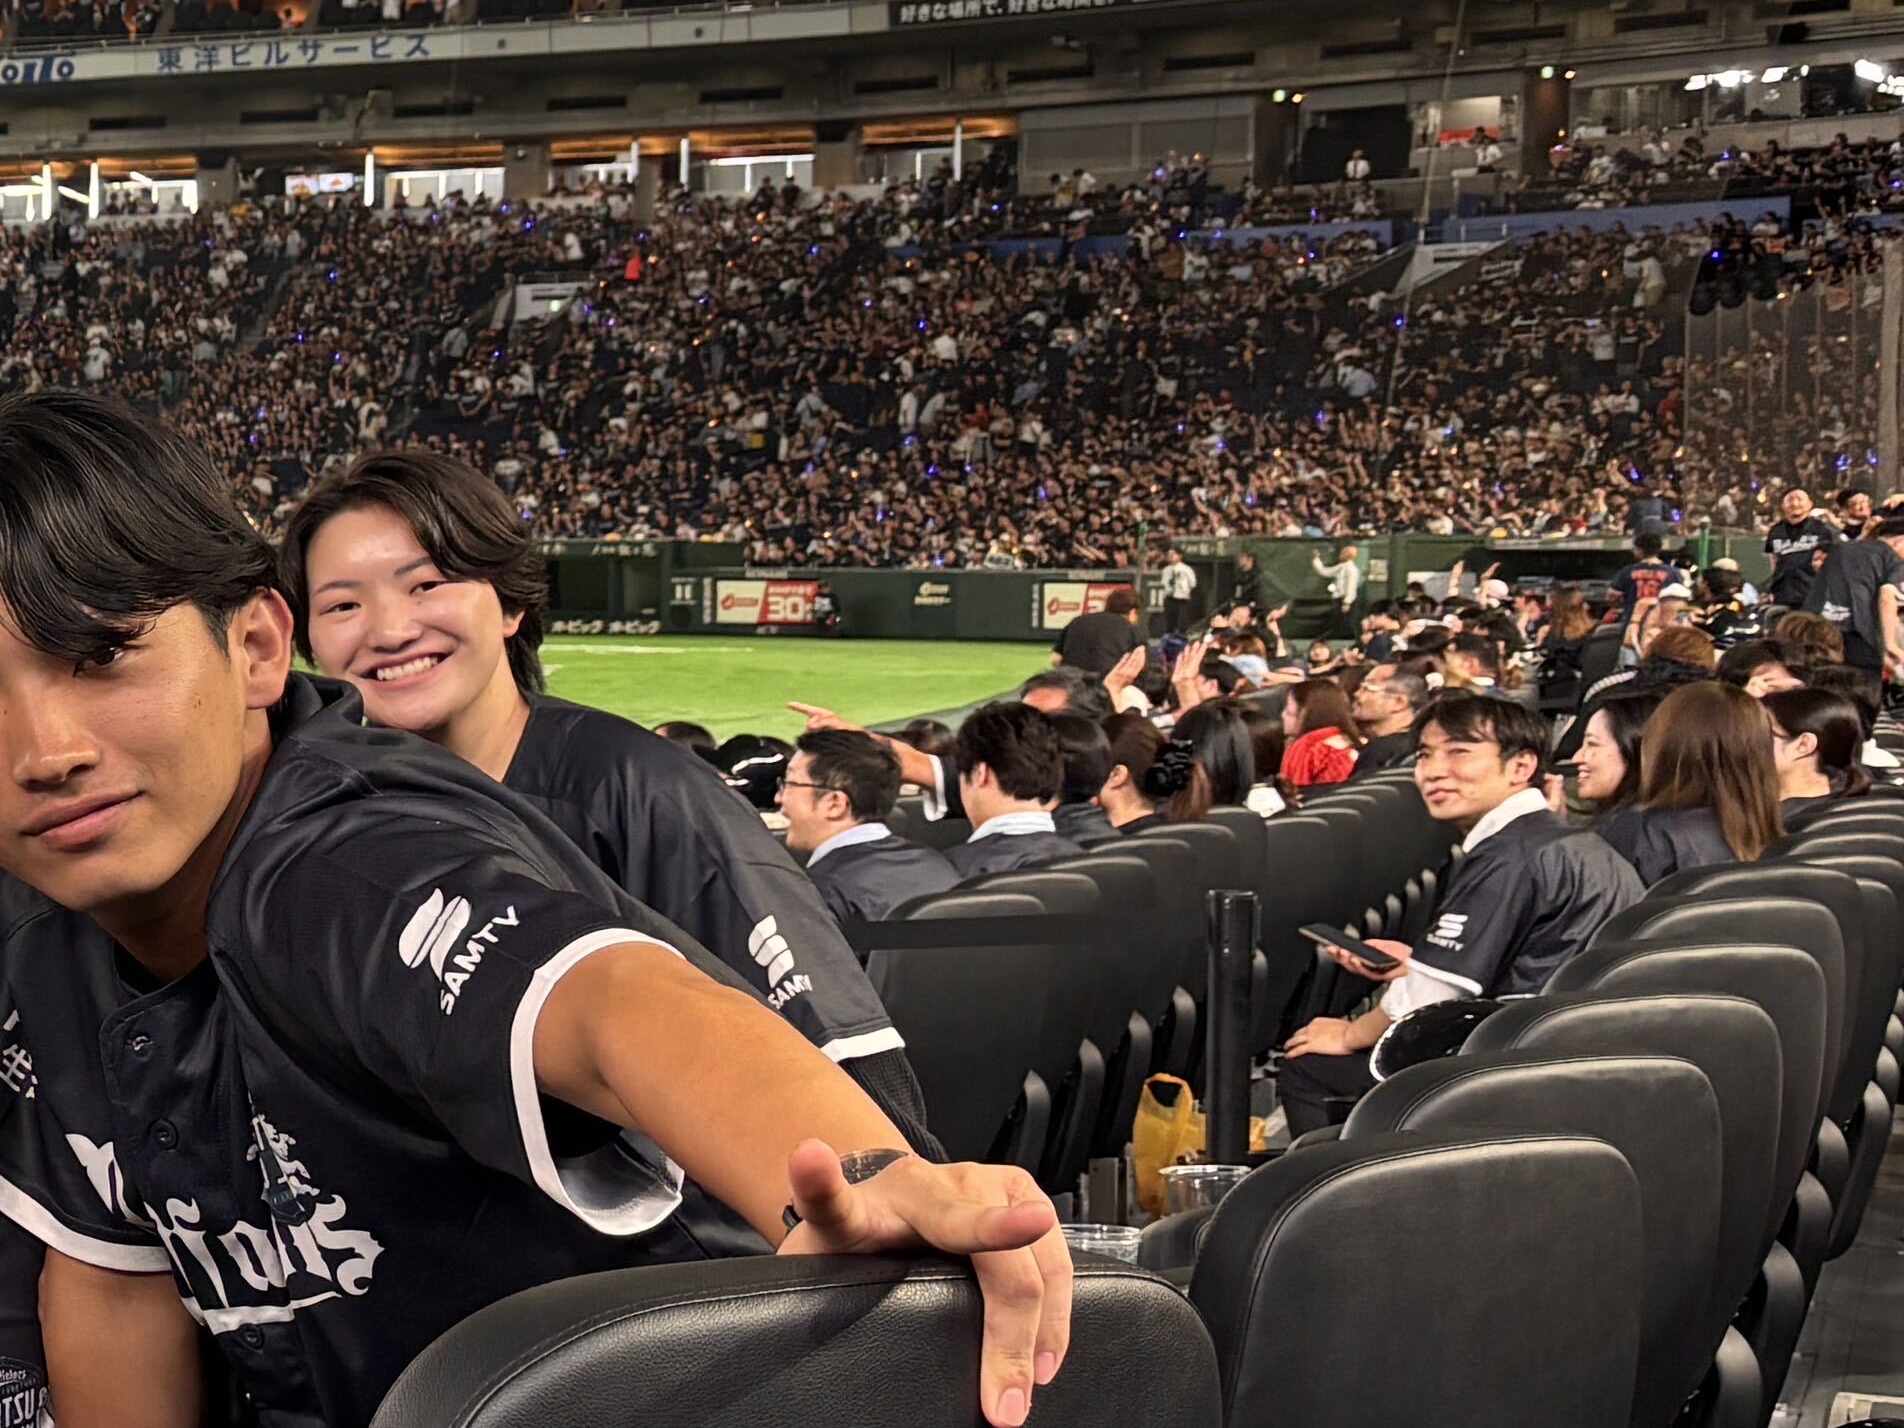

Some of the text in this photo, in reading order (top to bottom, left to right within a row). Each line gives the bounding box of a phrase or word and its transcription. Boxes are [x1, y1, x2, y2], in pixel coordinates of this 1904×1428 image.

[158, 34, 429, 70] 東洋ビルサービス
[440, 903, 520, 1015] SAMTY
